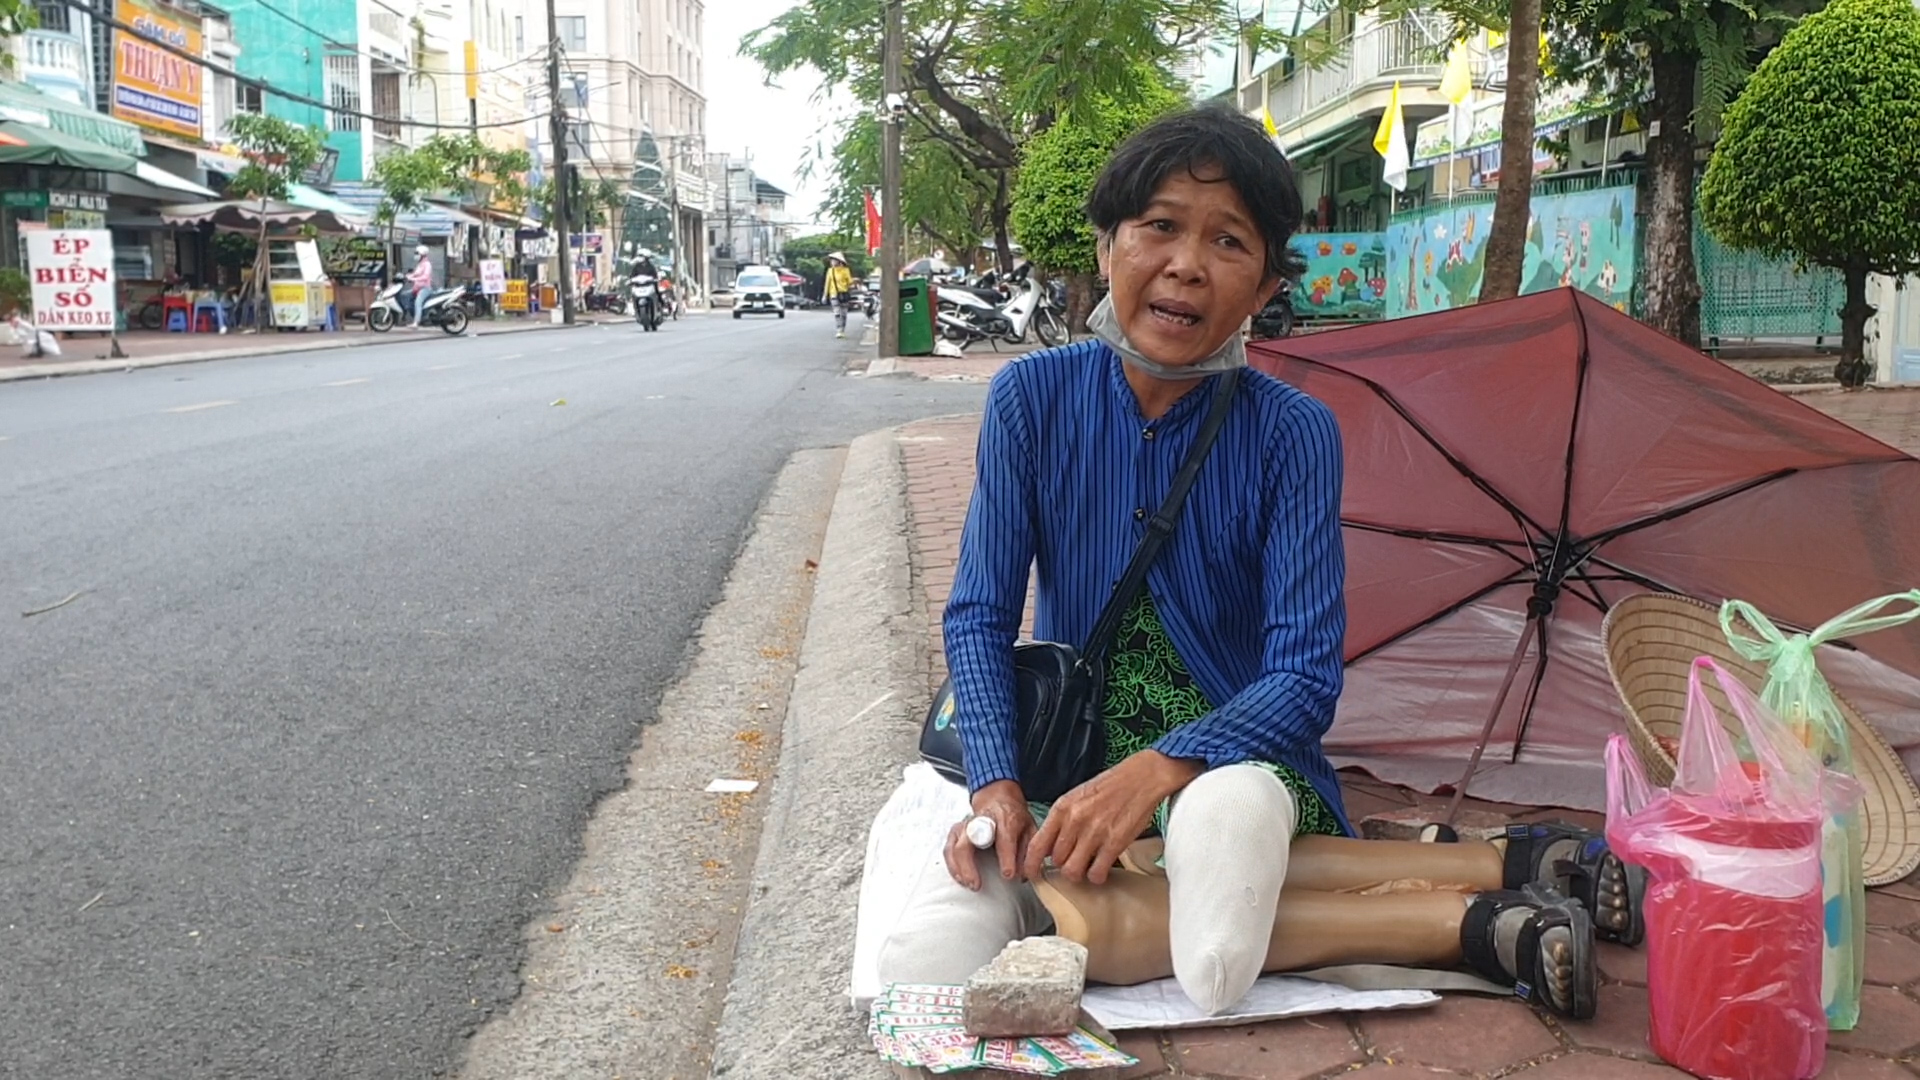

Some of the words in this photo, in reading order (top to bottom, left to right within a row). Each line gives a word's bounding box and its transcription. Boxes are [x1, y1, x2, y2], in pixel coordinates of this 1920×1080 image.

[53, 233, 89, 255] ÉP
[35, 258, 107, 284] BIỂN
[55, 283, 92, 307] SỐ
[96, 311, 112, 326] XE
